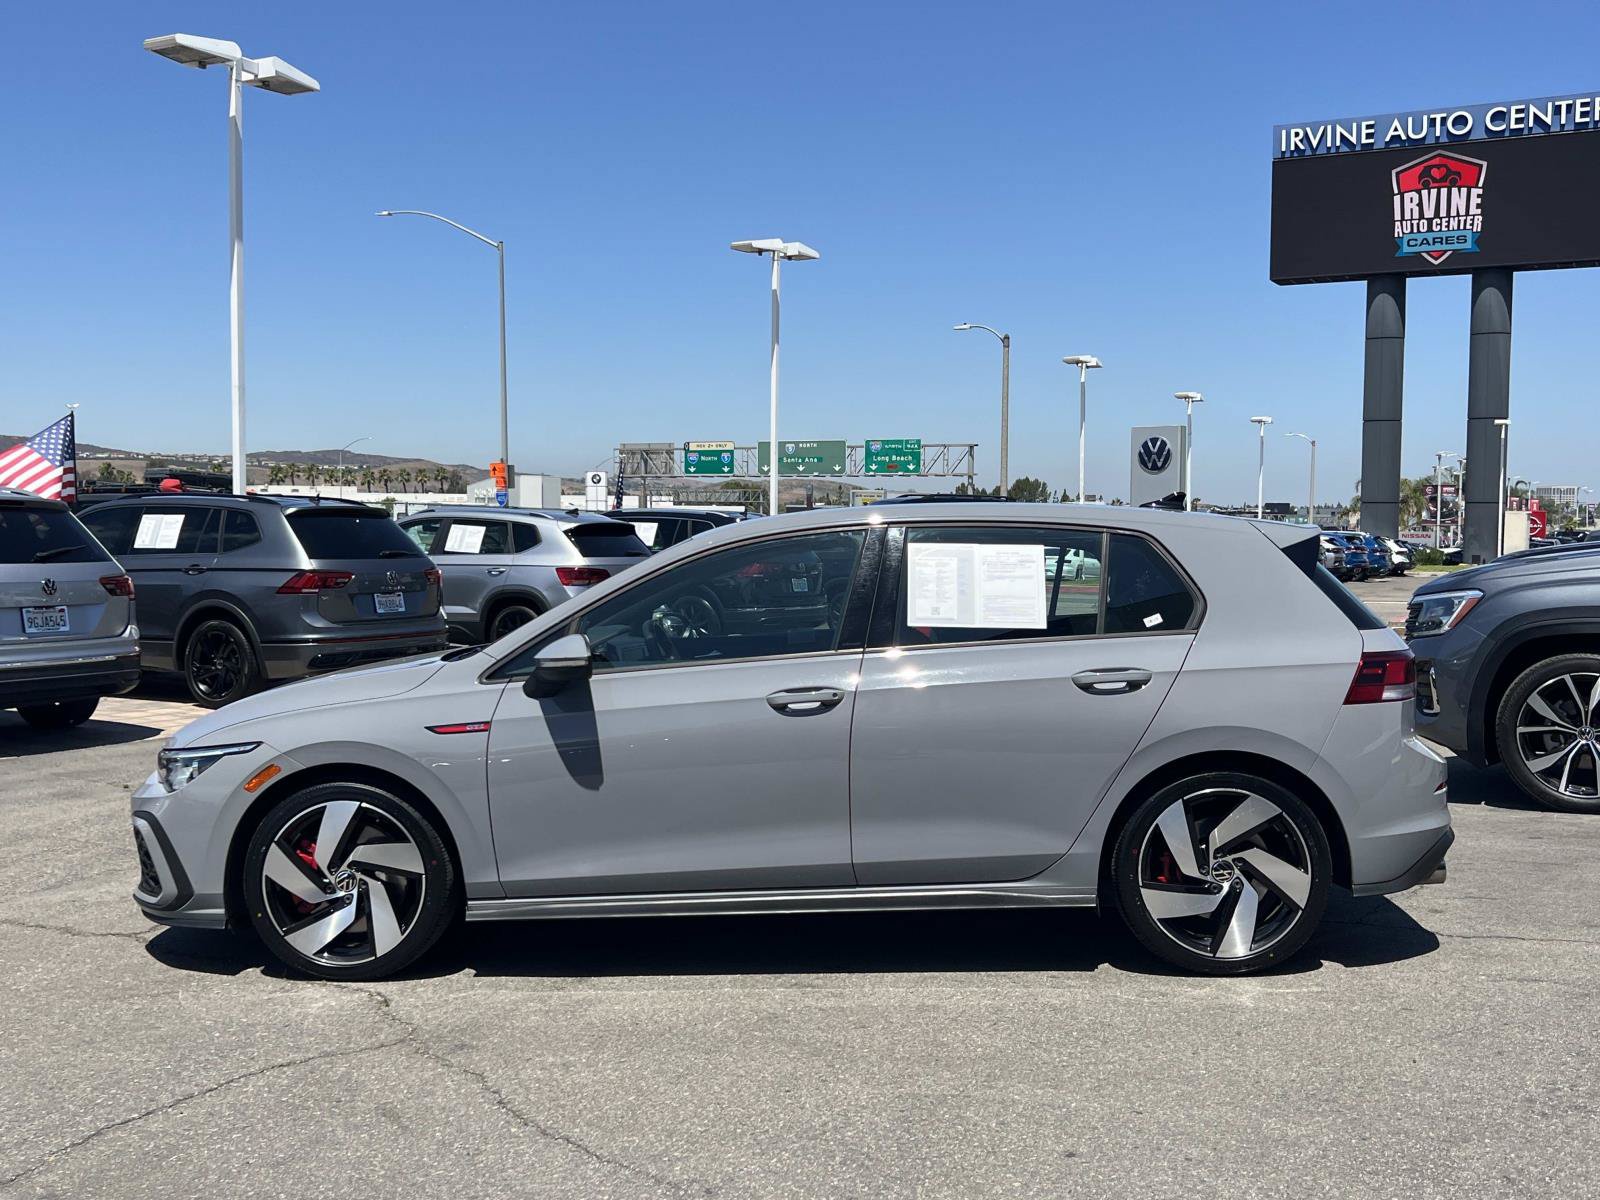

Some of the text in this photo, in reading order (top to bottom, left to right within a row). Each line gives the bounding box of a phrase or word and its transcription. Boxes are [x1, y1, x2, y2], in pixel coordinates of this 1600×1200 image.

[1281, 120, 1375, 152] IRVINE
[1384, 111, 1473, 142] AUTO
[1393, 187, 1483, 220] IRVINE
[1394, 215, 1482, 237] AUTO CENTER
[1407, 235, 1468, 247] CARES
[27, 614, 66, 629] 9GJA545
